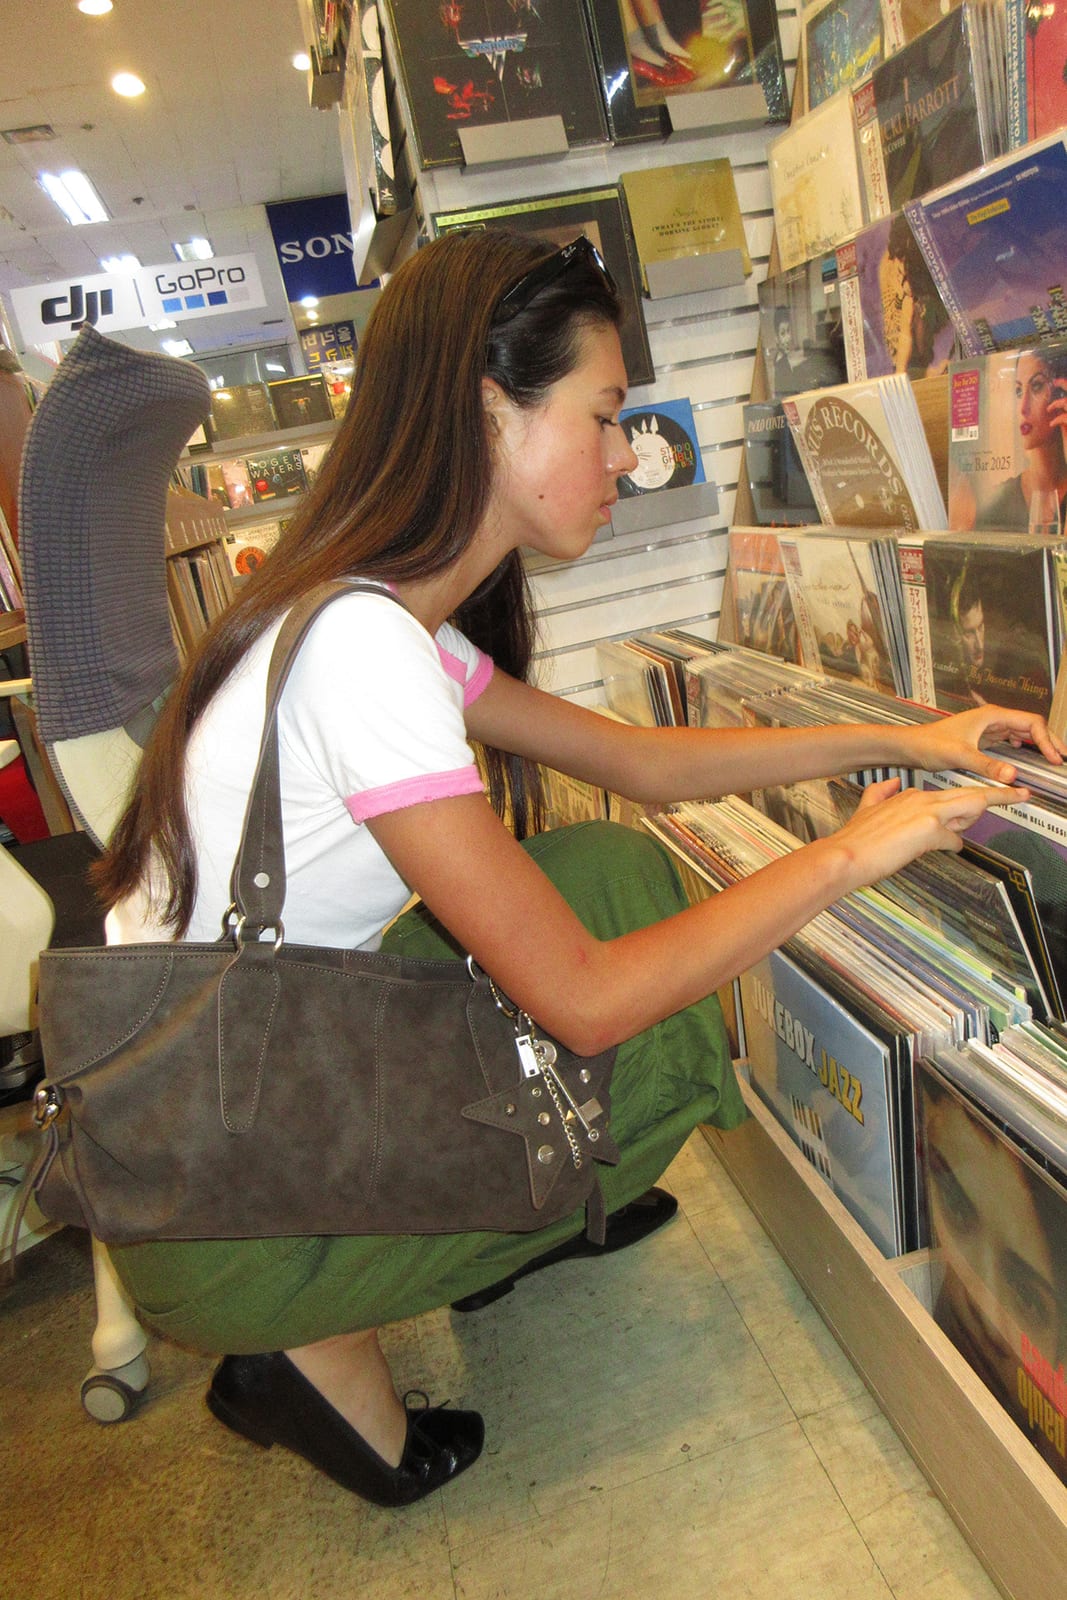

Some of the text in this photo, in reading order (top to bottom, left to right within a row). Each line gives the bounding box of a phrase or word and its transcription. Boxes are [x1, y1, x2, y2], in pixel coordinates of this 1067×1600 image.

[904, 75, 959, 129] PARROTT
[280, 232, 354, 264] SON
[155, 266, 246, 295] GoPro
[660, 442, 691, 456] STUDIO
[662, 450, 693, 464] GHIBLI
[820, 405, 904, 495] RECORDS
[249, 454, 301, 470] ROGER
[251, 463, 302, 478] WATERS
[991, 455, 1011, 471] 2025
[1018, 675, 1048, 699] Things
[1010, 806, 1028, 820] THOM
[1030, 815, 1045, 828] BELL
[752, 975, 865, 1127] JUKEBOX JAZZ
